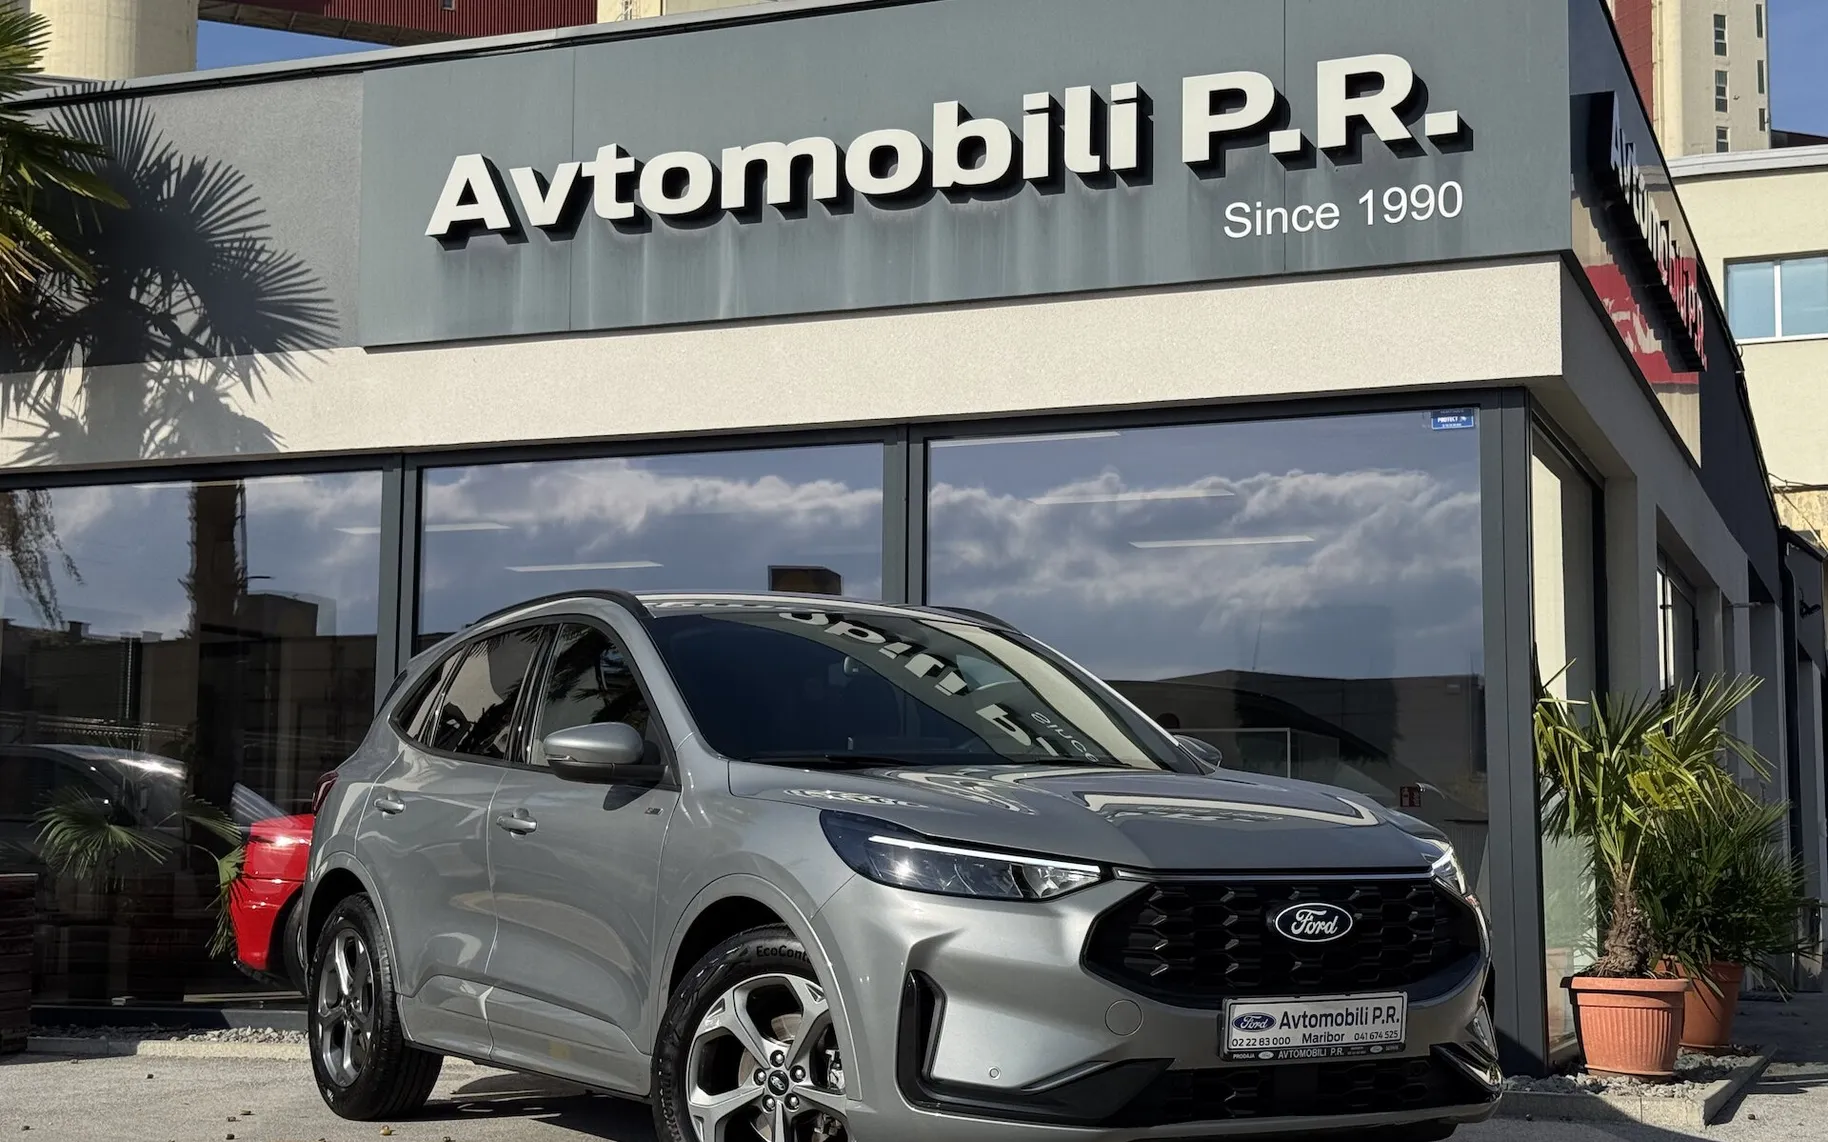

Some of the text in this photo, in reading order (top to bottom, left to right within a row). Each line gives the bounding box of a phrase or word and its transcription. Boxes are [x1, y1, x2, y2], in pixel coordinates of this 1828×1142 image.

[425, 53, 1459, 237] Avtomobili P.R.
[1223, 181, 1464, 239] Since 1990
[1290, 909, 1340, 935] Ford
[1240, 1005, 1400, 1030] Ford Avtomobili P.R.
[1231, 1030, 1399, 1047] 02 22 83 000 Maribor 041 674 525
[1277, 1048, 1327, 1059] AVTOMOBILI
[1330, 1047, 1345, 1056] P.R.
